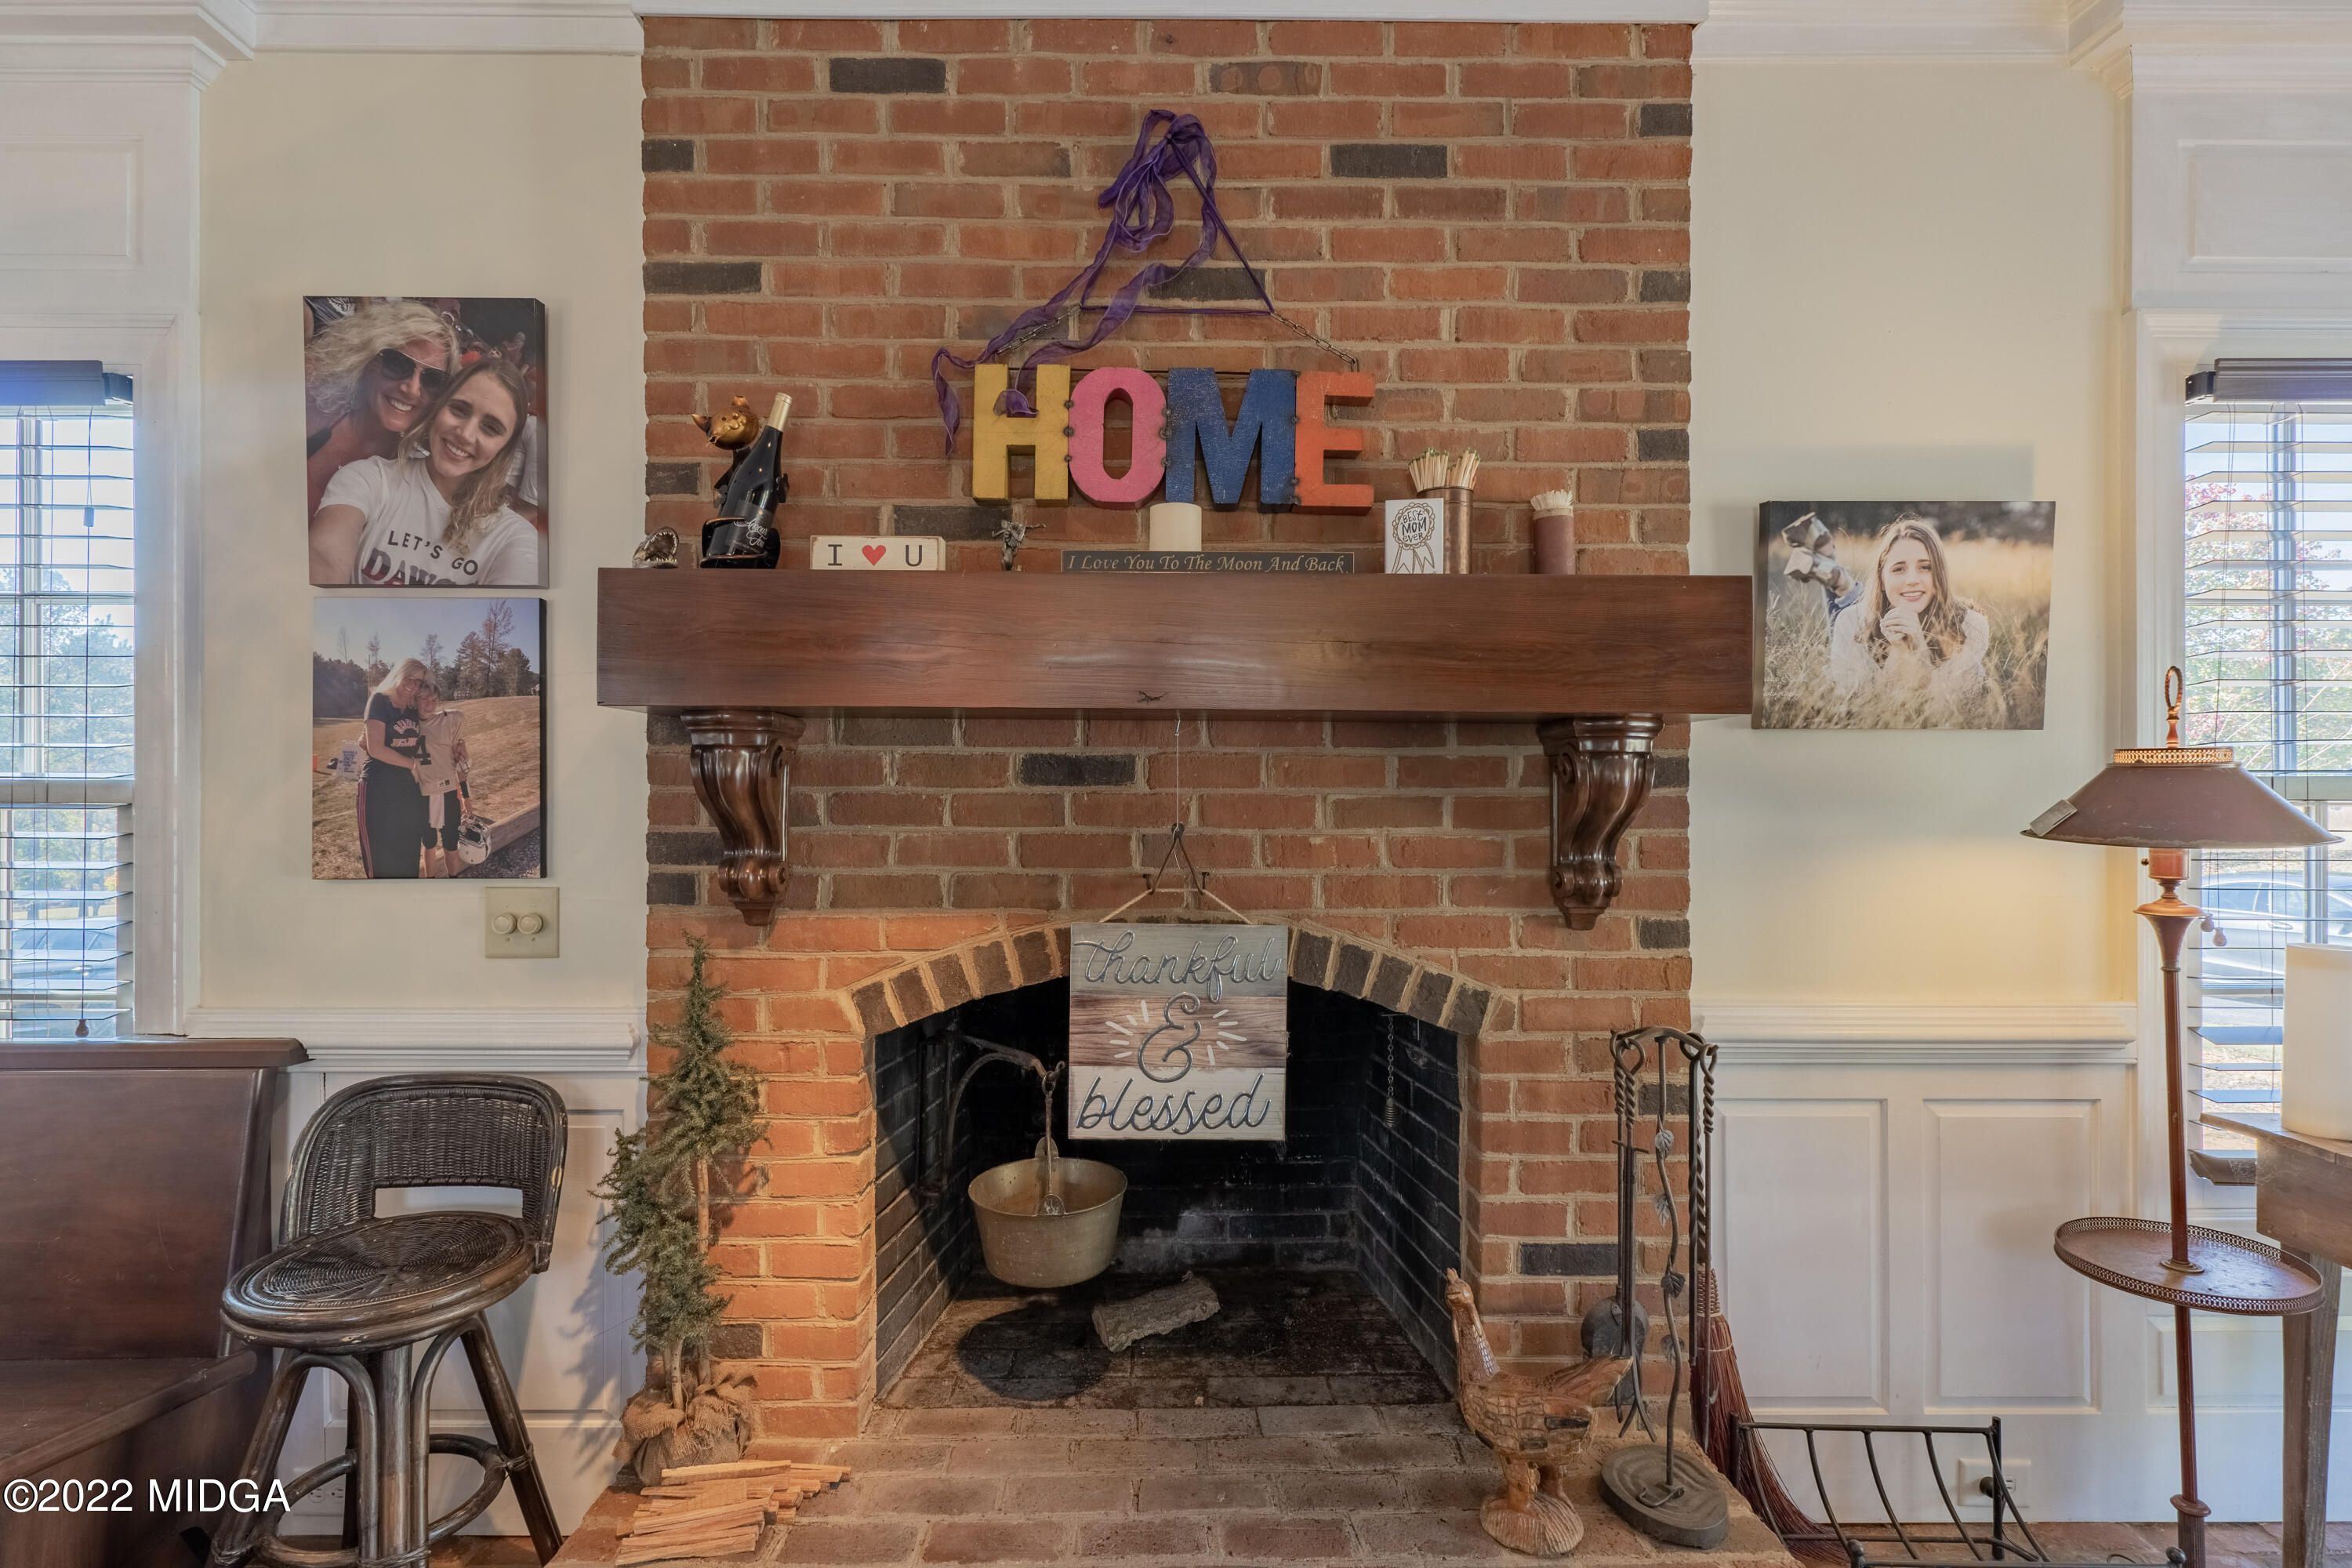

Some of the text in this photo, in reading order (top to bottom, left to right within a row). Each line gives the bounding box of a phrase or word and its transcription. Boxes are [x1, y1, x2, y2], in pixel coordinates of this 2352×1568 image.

[973, 364, 1376, 515] HOME
[1402, 517, 1427, 535] MOM
[361, 547, 478, 585] DAW
[387, 530, 478, 576] LET'S GO
[828, 544, 923, 567] I U
[1067, 555, 1079, 569] I
[1080, 555, 1120, 570] Love
[1123, 554, 1155, 570] You
[1160, 554, 1180, 570] To
[1184, 554, 1212, 571] The
[1217, 556, 1263, 572] Moon
[1265, 555, 1305, 572] And
[1073, 930, 1282, 1004] thankful
[1139, 992, 1200, 1083] &
[1076, 1073, 1272, 1134] blessed
